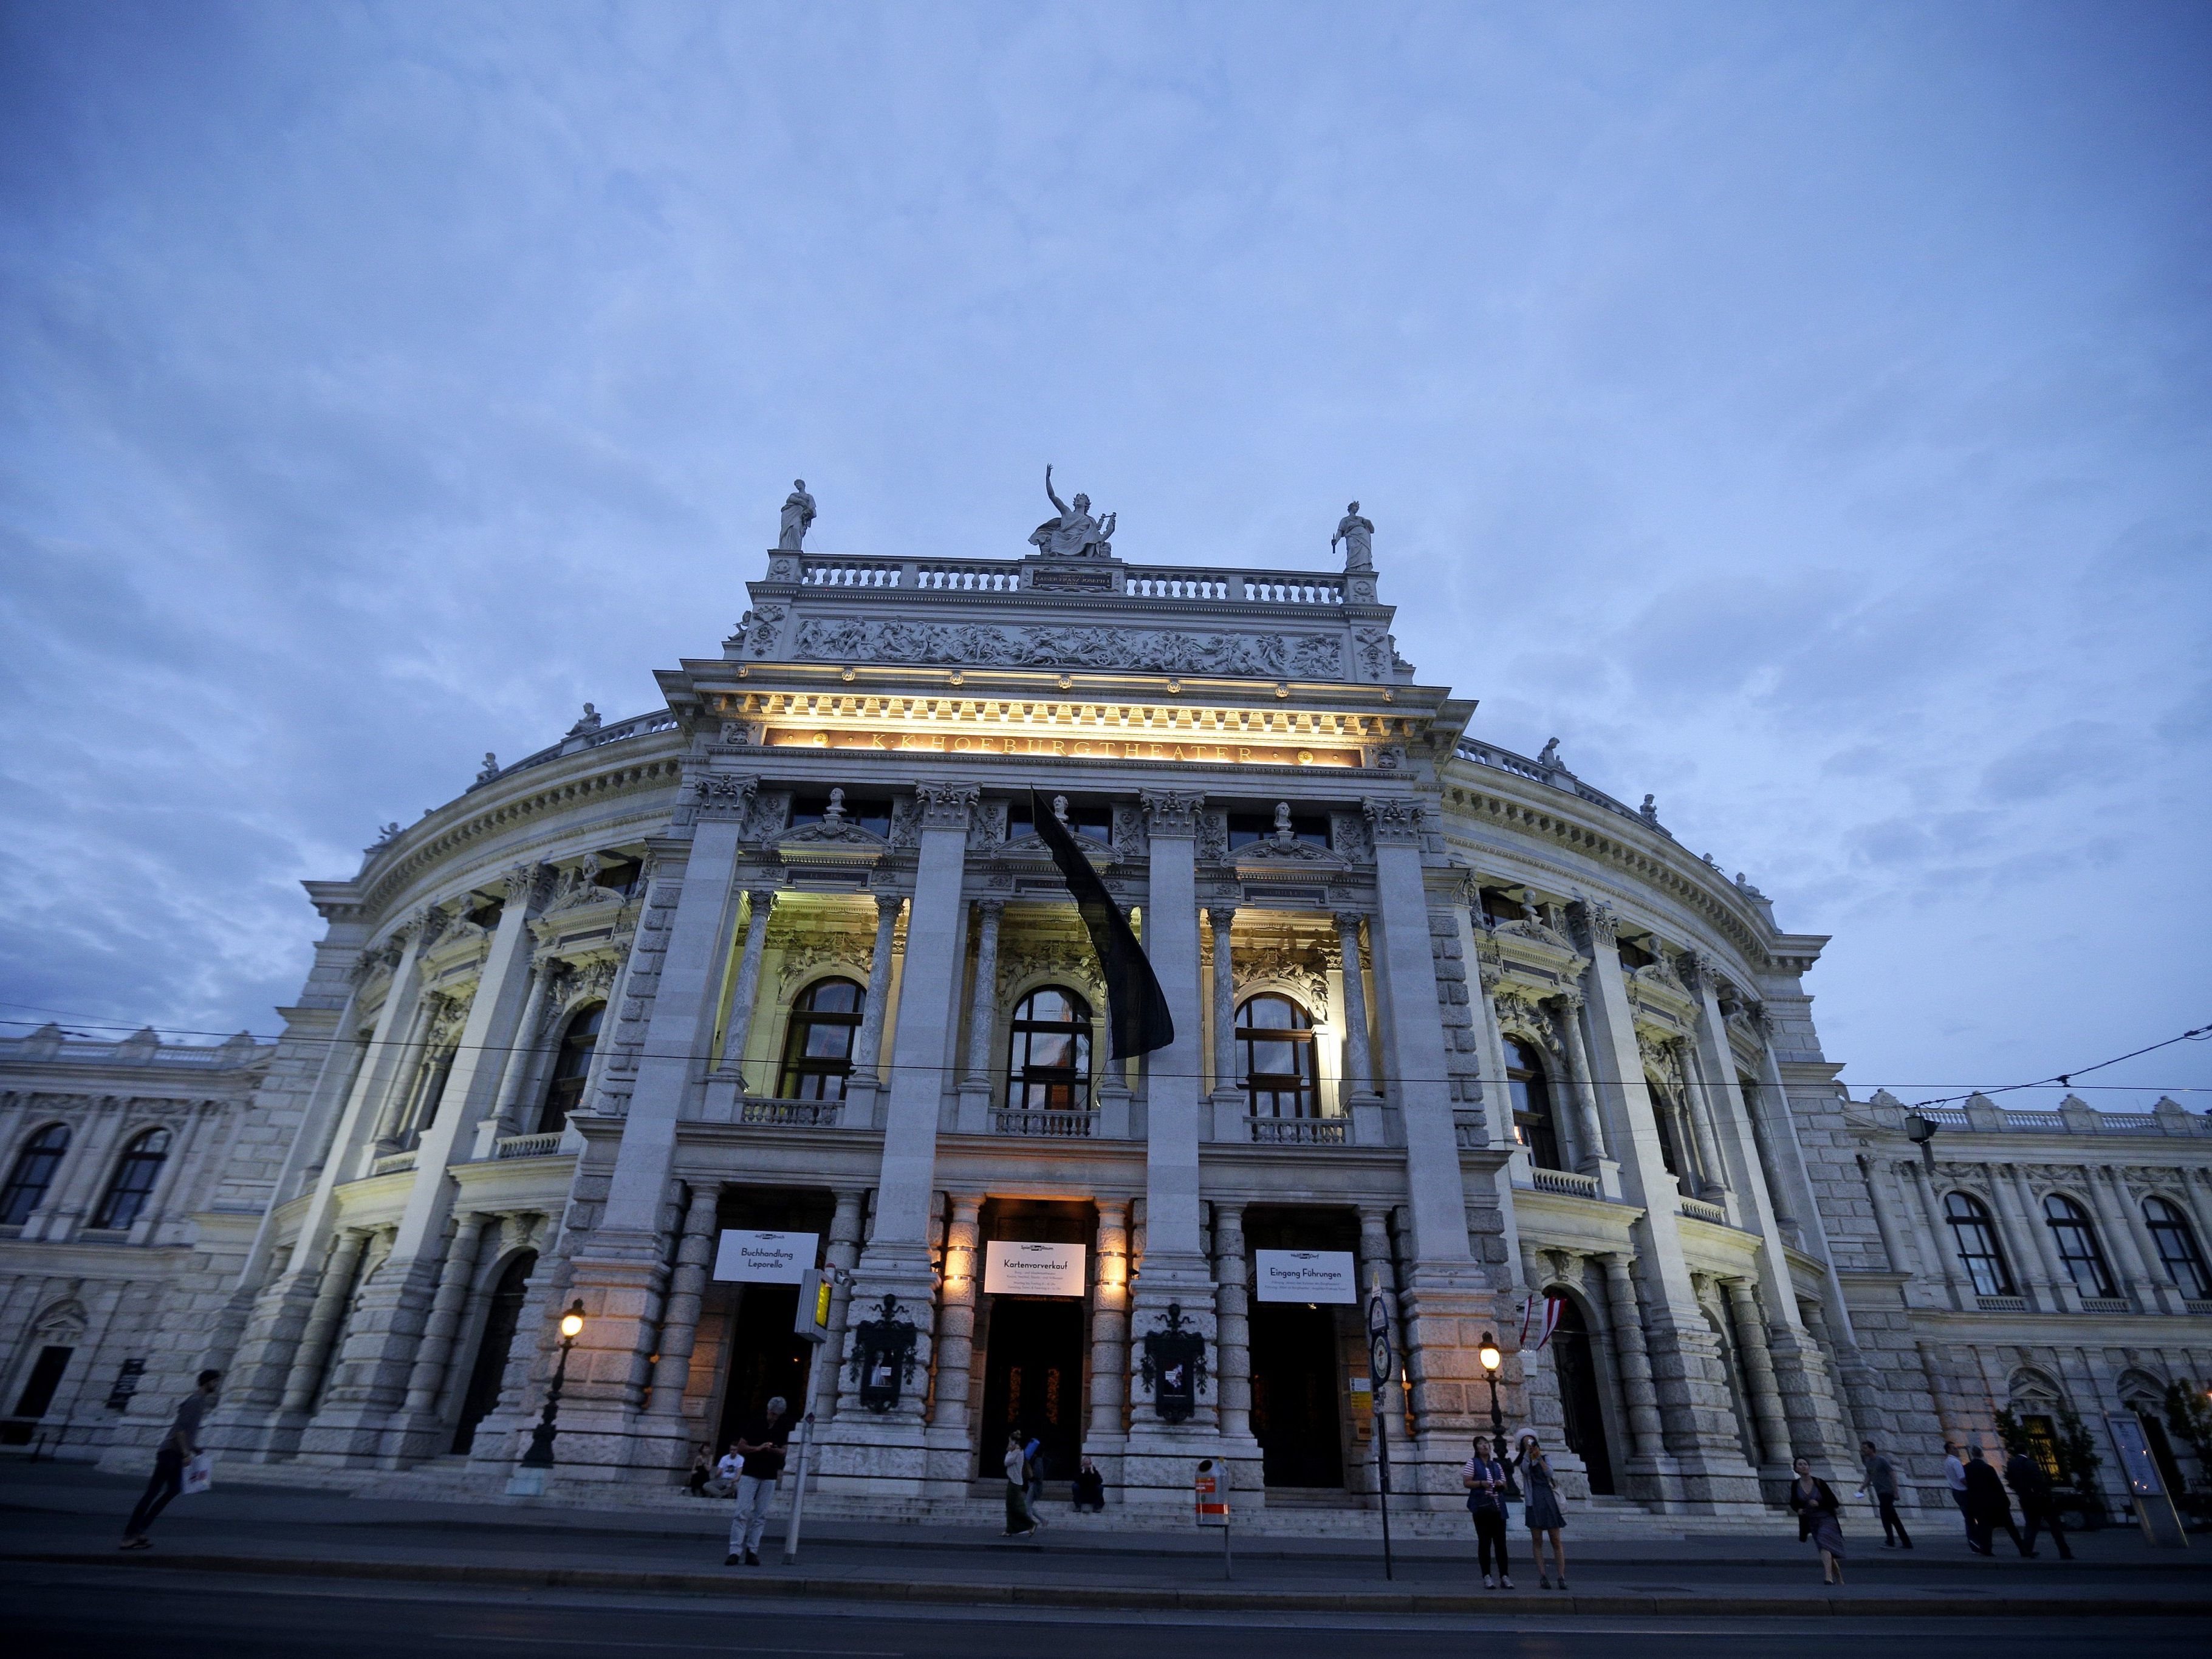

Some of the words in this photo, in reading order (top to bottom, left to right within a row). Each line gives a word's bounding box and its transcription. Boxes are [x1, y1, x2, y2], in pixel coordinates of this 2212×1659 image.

[741, 1247, 793, 1260] Buchhandlung
[748, 1259, 783, 1270] Leporello
[1004, 1259, 1068, 1270] Kartenvorverkauf
[1270, 1267, 1301, 1279] Eingang
[1303, 1268, 1342, 1280] Führungen
